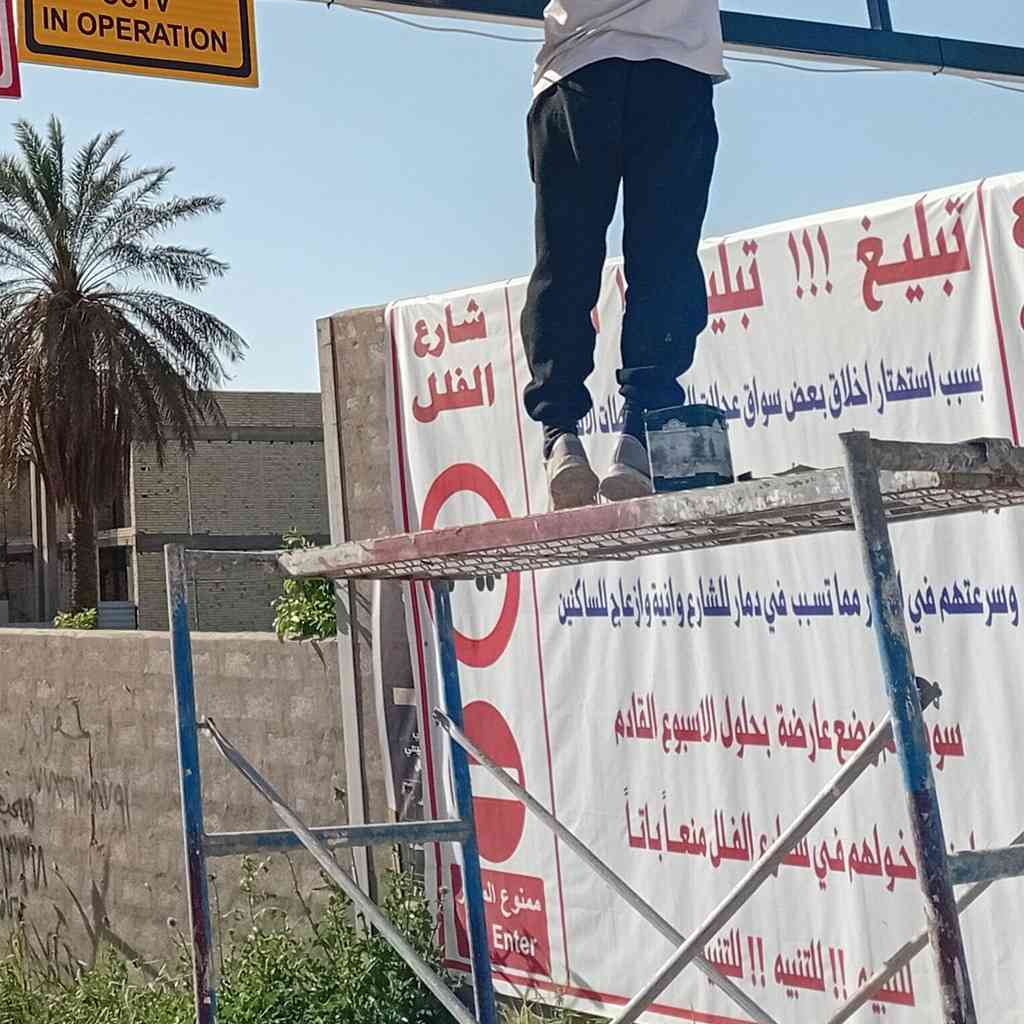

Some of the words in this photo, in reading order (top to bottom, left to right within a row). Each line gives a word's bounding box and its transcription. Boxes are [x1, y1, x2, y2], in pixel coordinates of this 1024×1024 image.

[42, 6, 68, 32] IN
[77, 12, 227, 53] OPERATION
[857, 196, 971, 312] تبليغ
[708, 239, 764, 334] تبلي
[414, 298, 487, 358] شارع
[412, 362, 495, 423] الفلل
[744, 376, 782, 428] سواق
[784, 381, 827, 422] بعض
[829, 359, 872, 418] اخلاق
[877, 352, 937, 414] استهتار
[939, 362, 984, 406] بسبب
[687, 574, 731, 627] للشارع
[764, 580, 787, 633] في
[791, 579, 833, 626] تسبب
[835, 569, 861, 617] مما
[908, 577, 936, 633] في
[939, 577, 1018, 626] وسرعتهم
[615, 691, 658, 746] القادم
[662, 694, 717, 755] الاسبوع
[721, 694, 770, 758] بحلول
[776, 697, 832, 763] عارضة
[710, 808, 753, 868] الفلل
[813, 827, 846, 891] في
[848, 824, 917, 892] خولهم
[501, 887, 542, 918] ممنوع
[492, 923, 538, 956] Enter
